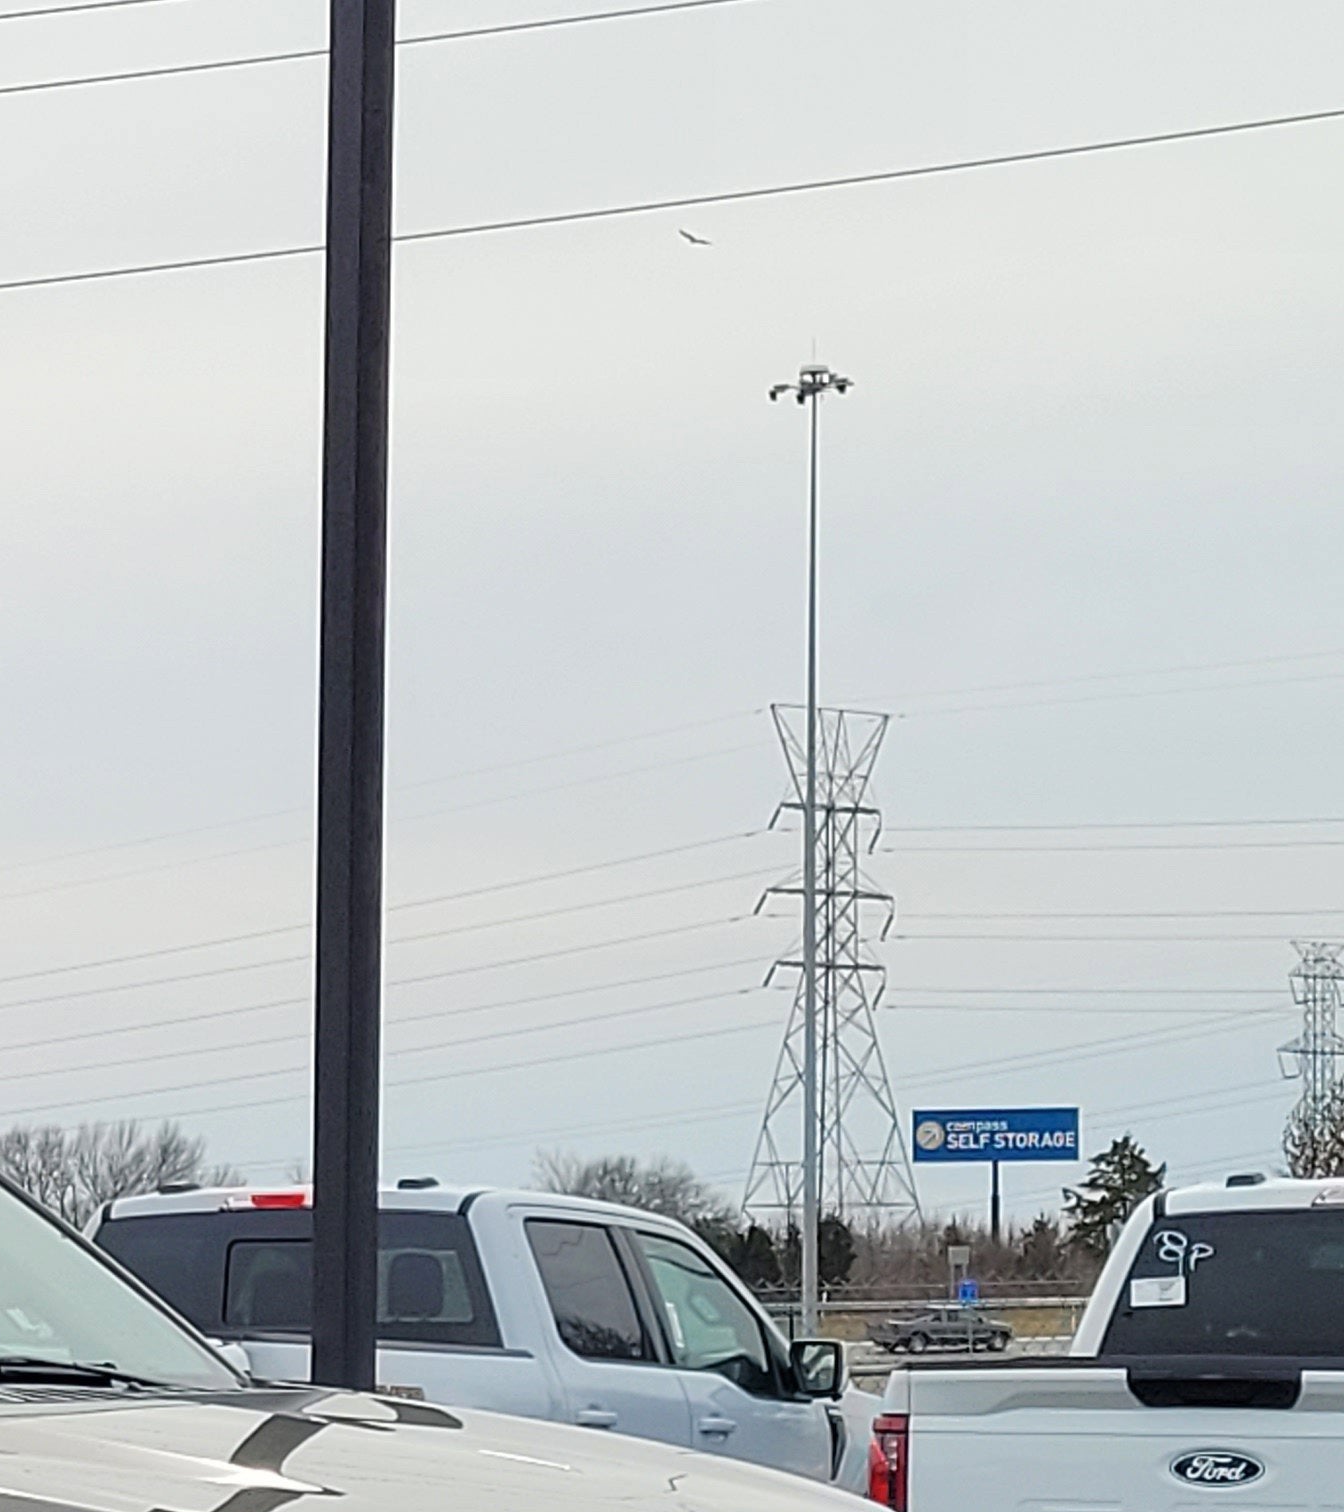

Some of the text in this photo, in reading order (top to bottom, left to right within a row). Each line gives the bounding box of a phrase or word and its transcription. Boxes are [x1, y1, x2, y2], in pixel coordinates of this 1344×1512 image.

[946, 1131, 1075, 1149] SELF STORAGE
[1186, 1456, 1248, 1480] Ford
